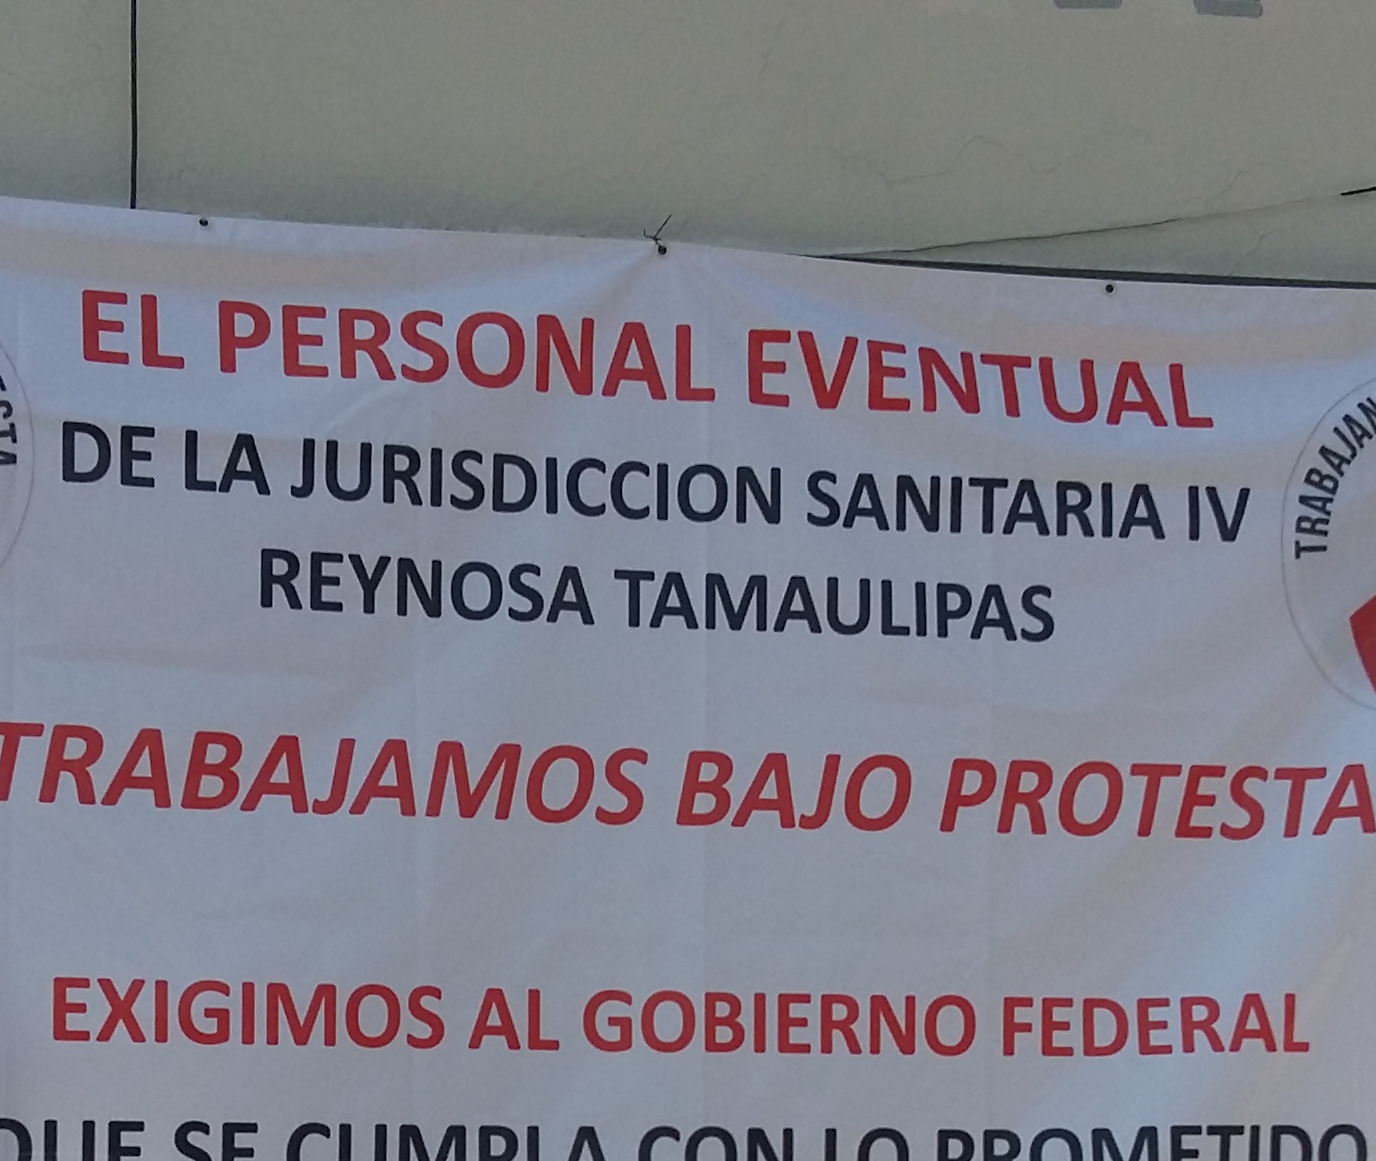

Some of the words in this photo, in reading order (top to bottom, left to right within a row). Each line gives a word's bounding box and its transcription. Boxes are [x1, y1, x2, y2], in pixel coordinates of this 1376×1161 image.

[81, 289, 185, 369] EL
[219, 300, 716, 402] PERSONAL
[747, 328, 1214, 428] EVENTUAL
[61, 420, 155, 488] DE
[185, 429, 271, 496] LA
[290, 438, 782, 525] JURISDICCION
[806, 470, 1165, 541] SANITARIA
[1187, 485, 1250, 542] IV
[259, 548, 595, 626] REYNOSA
[614, 569, 1055, 643] TAMAULIPAS
[676, 749, 912, 831] BAJO
[52, 977, 445, 1049] EXIGIMOS
[468, 987, 559, 1051] AL
[583, 990, 977, 1057] GOBIERNO
[1001, 993, 1309, 1058] FEDERAL
